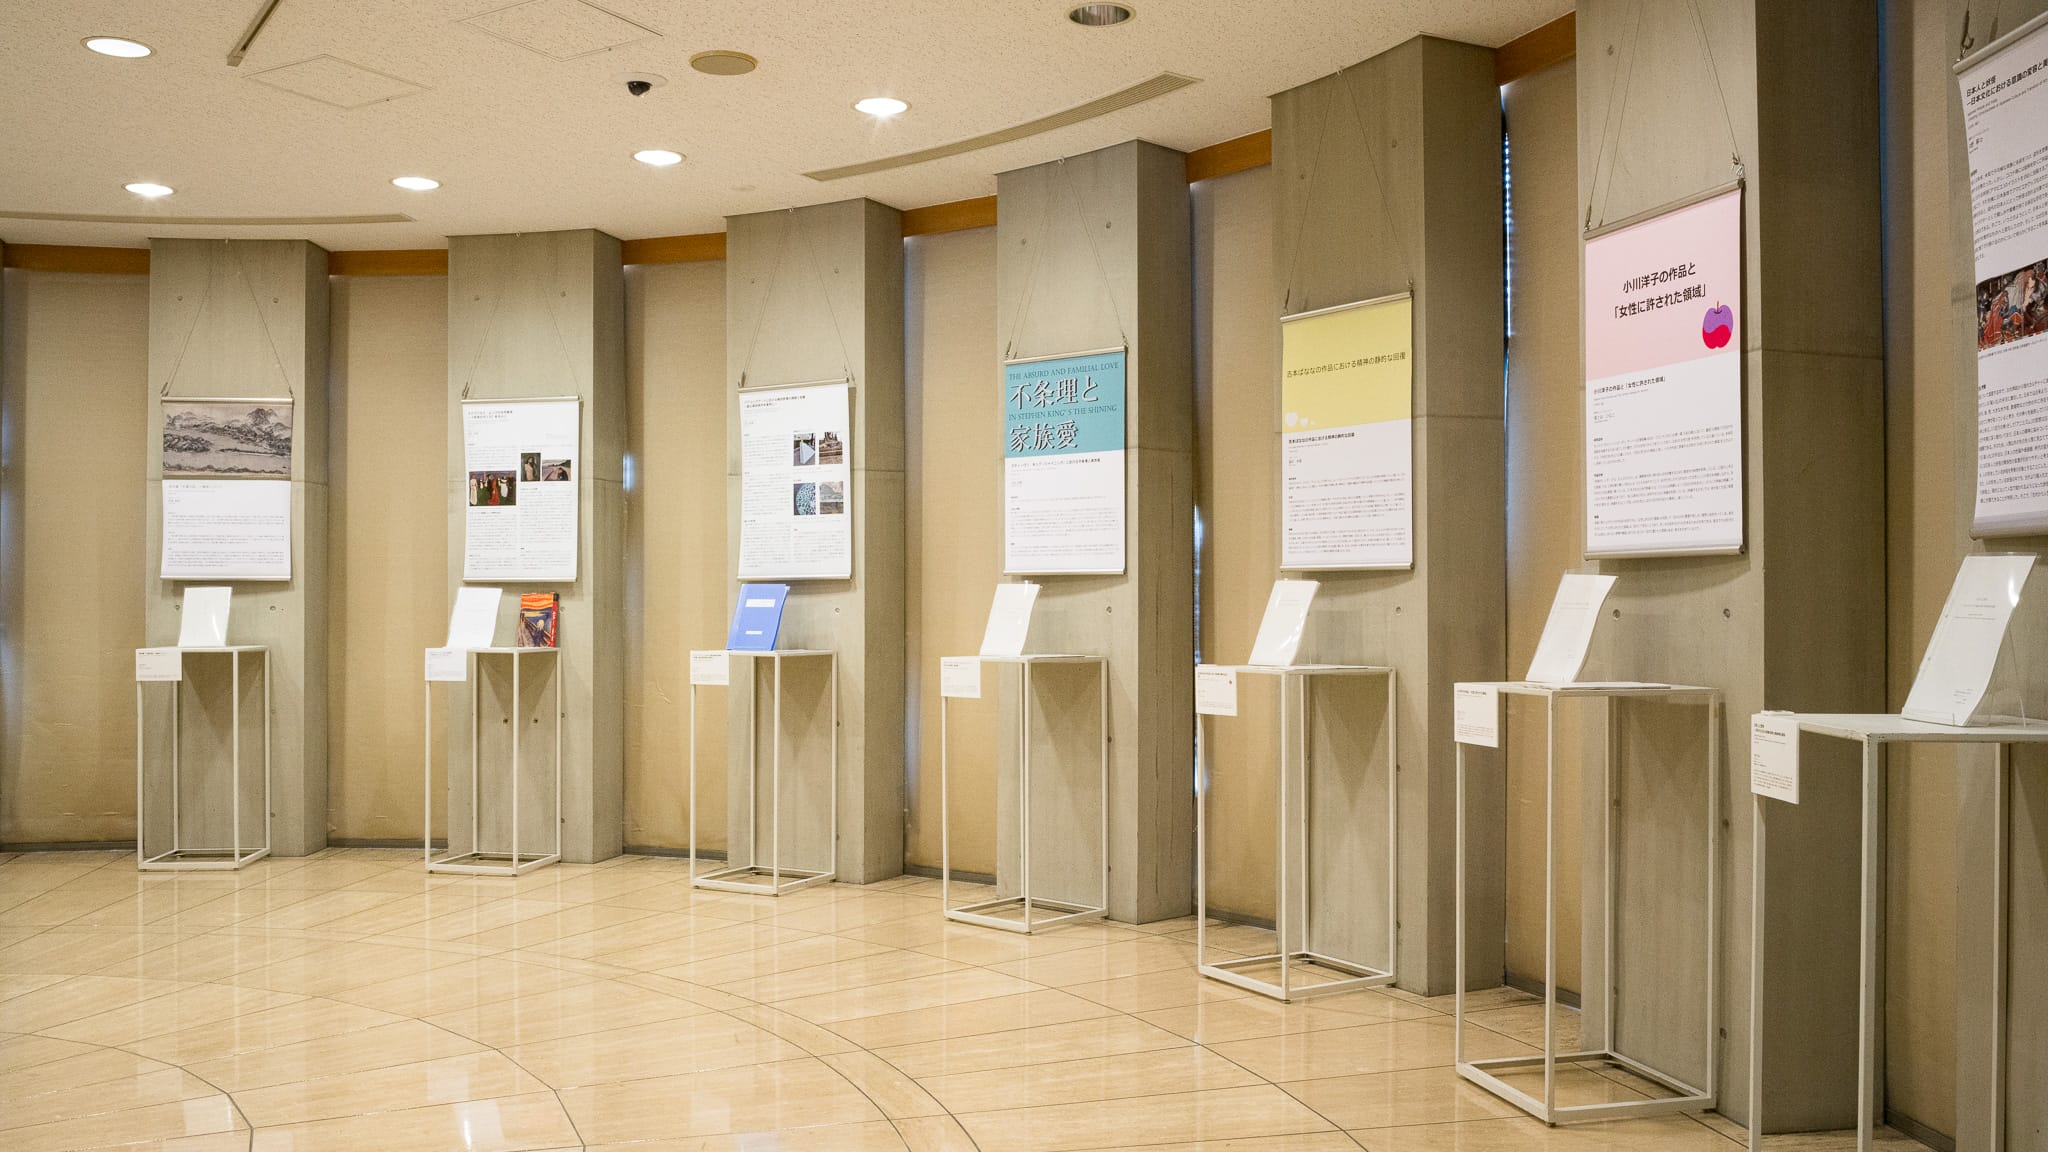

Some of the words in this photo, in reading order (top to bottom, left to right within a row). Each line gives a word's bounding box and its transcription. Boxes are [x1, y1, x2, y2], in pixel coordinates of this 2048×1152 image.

[1623, 262, 1696, 294] 小川洋子の作品と
[1614, 284, 1706, 318] 「女性に許された領域」
[1009, 373, 1021, 381] THE
[1023, 370, 1049, 380] ABSURD
[1051, 368, 1065, 376] AND
[1067, 364, 1098, 375] FAMILIAL
[1100, 362, 1119, 371] LOVE
[1010, 375, 1099, 410] 不条理と
[1008, 413, 1016, 421] IN
[1017, 411, 1046, 421] STEPHEN
[1074, 407, 1086, 415] THE
[1087, 404, 1117, 414] SHINING
[1010, 419, 1079, 453] 家族愛
